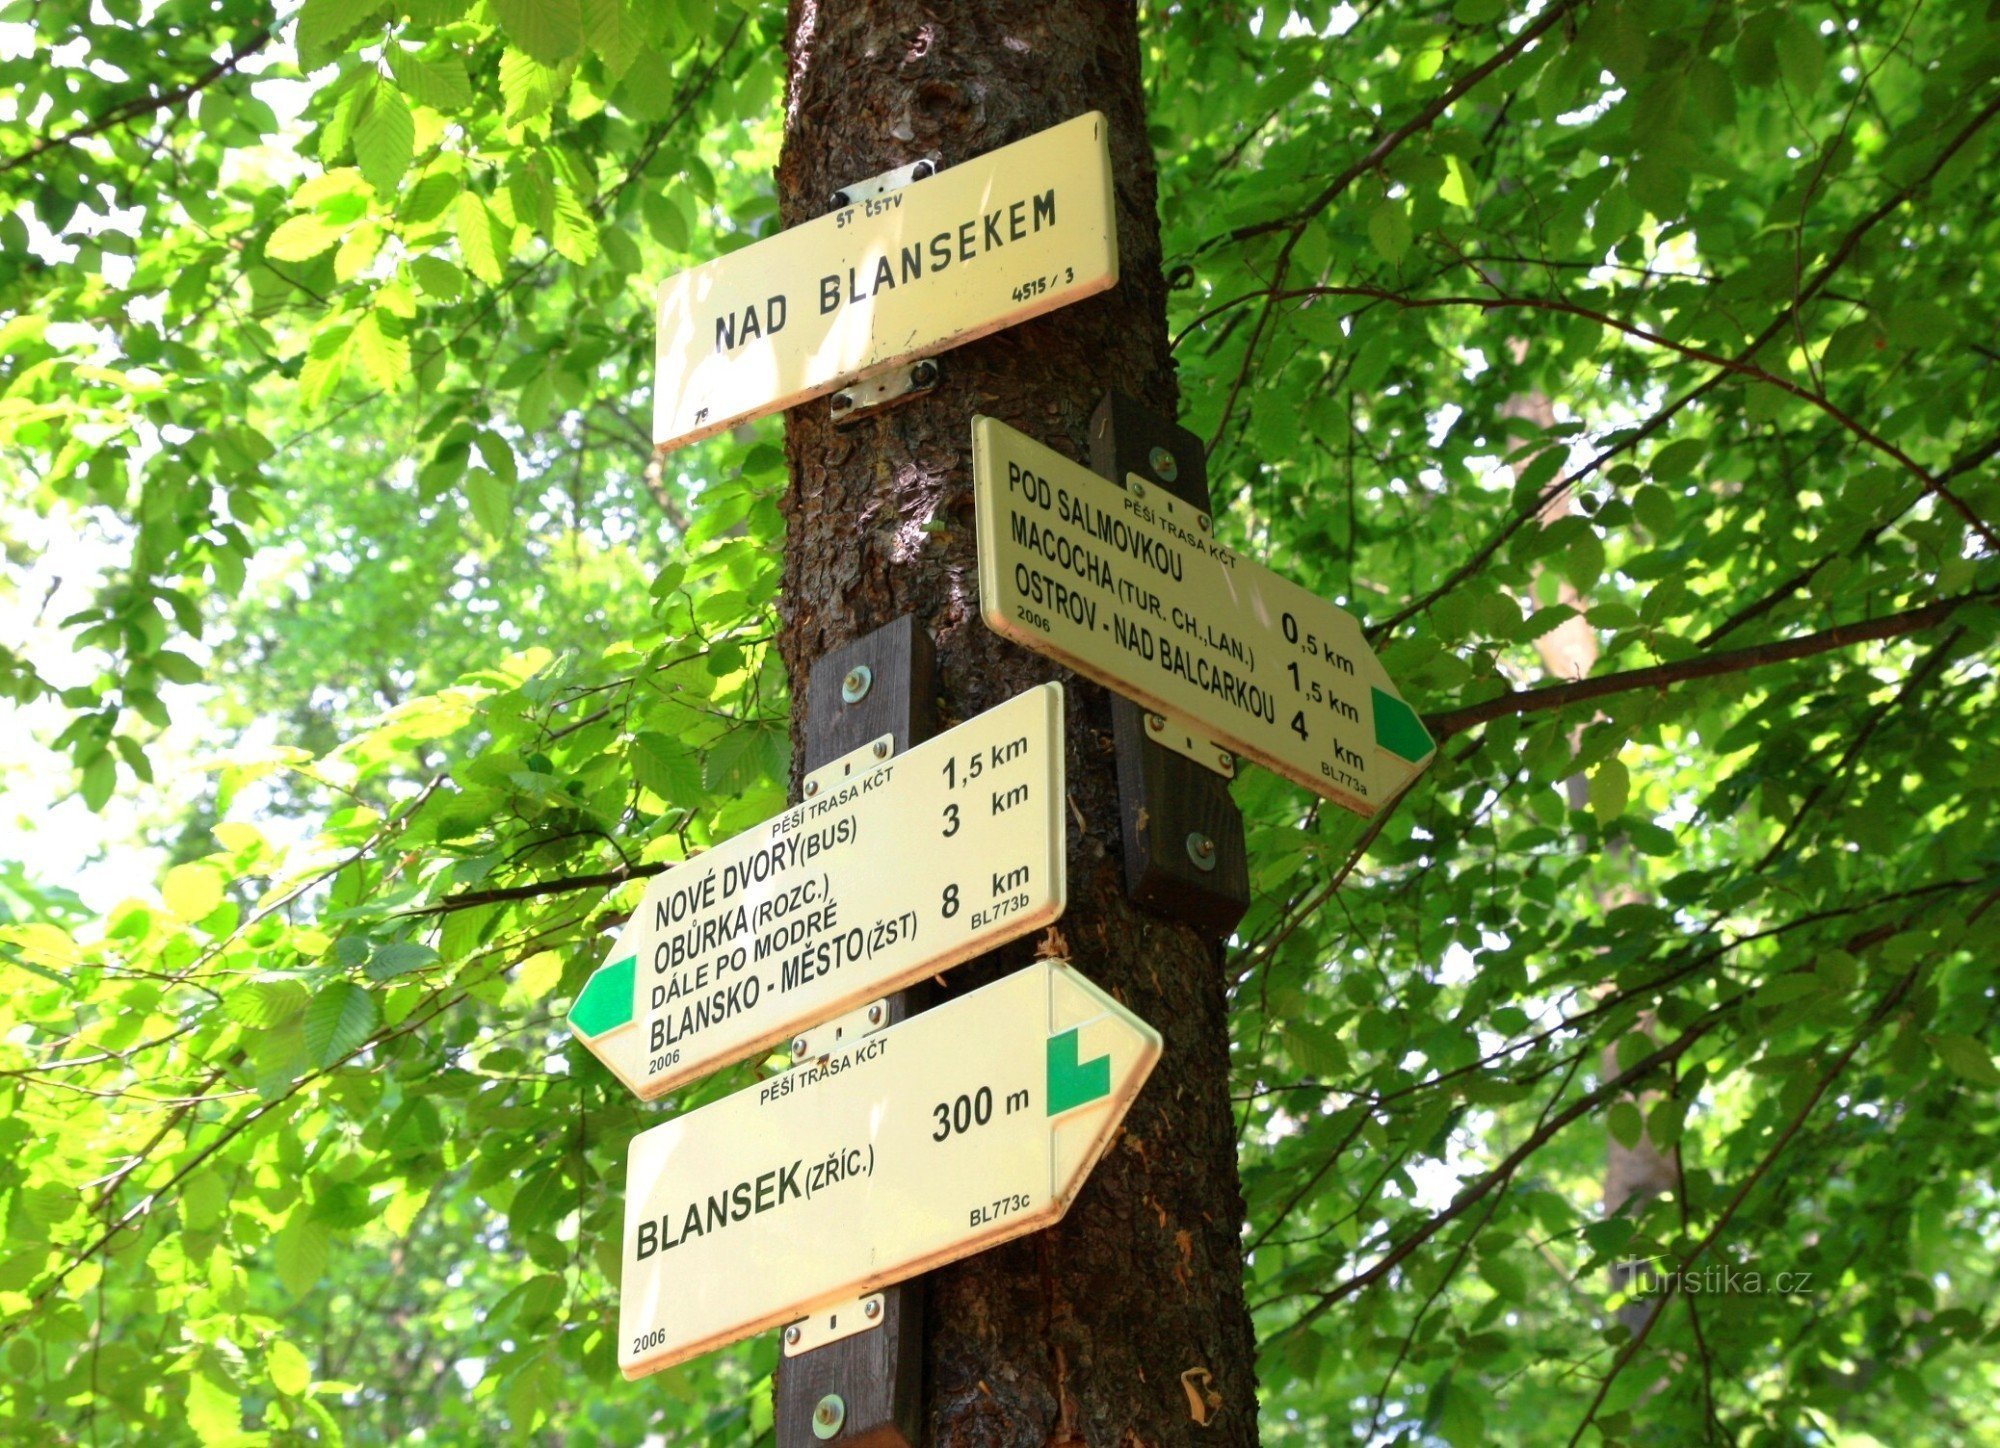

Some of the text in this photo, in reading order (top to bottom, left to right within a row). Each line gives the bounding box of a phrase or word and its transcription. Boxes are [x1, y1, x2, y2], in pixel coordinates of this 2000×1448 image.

[837, 209, 854, 228] ST
[715, 189, 1056, 353] NAD BLANSEKEM
[1124, 498, 1236, 568] PĚŠÍ TRASA KČT
[1008, 461, 1050, 511] POD
[1058, 489, 1183, 582] SALMOVKOU
[1323, 642, 1354, 676] km
[1017, 605, 1051, 633] 2006
[1015, 563, 1097, 632] OSTROV
[1113, 613, 1154, 661] NAD
[1160, 637, 1275, 725] BALCARKOU
[1291, 710, 1309, 742] 4
[1333, 738, 1365, 772] km
[1328, 690, 1359, 723] km
[772, 766, 894, 838] PĚŠÍ TRASA KČT
[1321, 761, 1368, 797] BL773a
[655, 868, 716, 932] NOVÉ
[991, 736, 1029, 770] km
[942, 803, 961, 839] 3
[991, 781, 1029, 817] km
[970, 892, 1030, 932] BL773b
[650, 975, 760, 1053] BLANSKO
[941, 883, 961, 920] 8
[991, 864, 1030, 899] km
[651, 898, 838, 1010] DÁLE PO MODRÉ
[649, 1049, 680, 1075] 2006
[760, 1038, 888, 1107] PĚŠÍ TRASA KČT
[933, 1085, 993, 1144] 300
[1005, 1089, 1030, 1116] m
[969, 1193, 1031, 1228] BL773c
[633, 1327, 667, 1355] 2006
